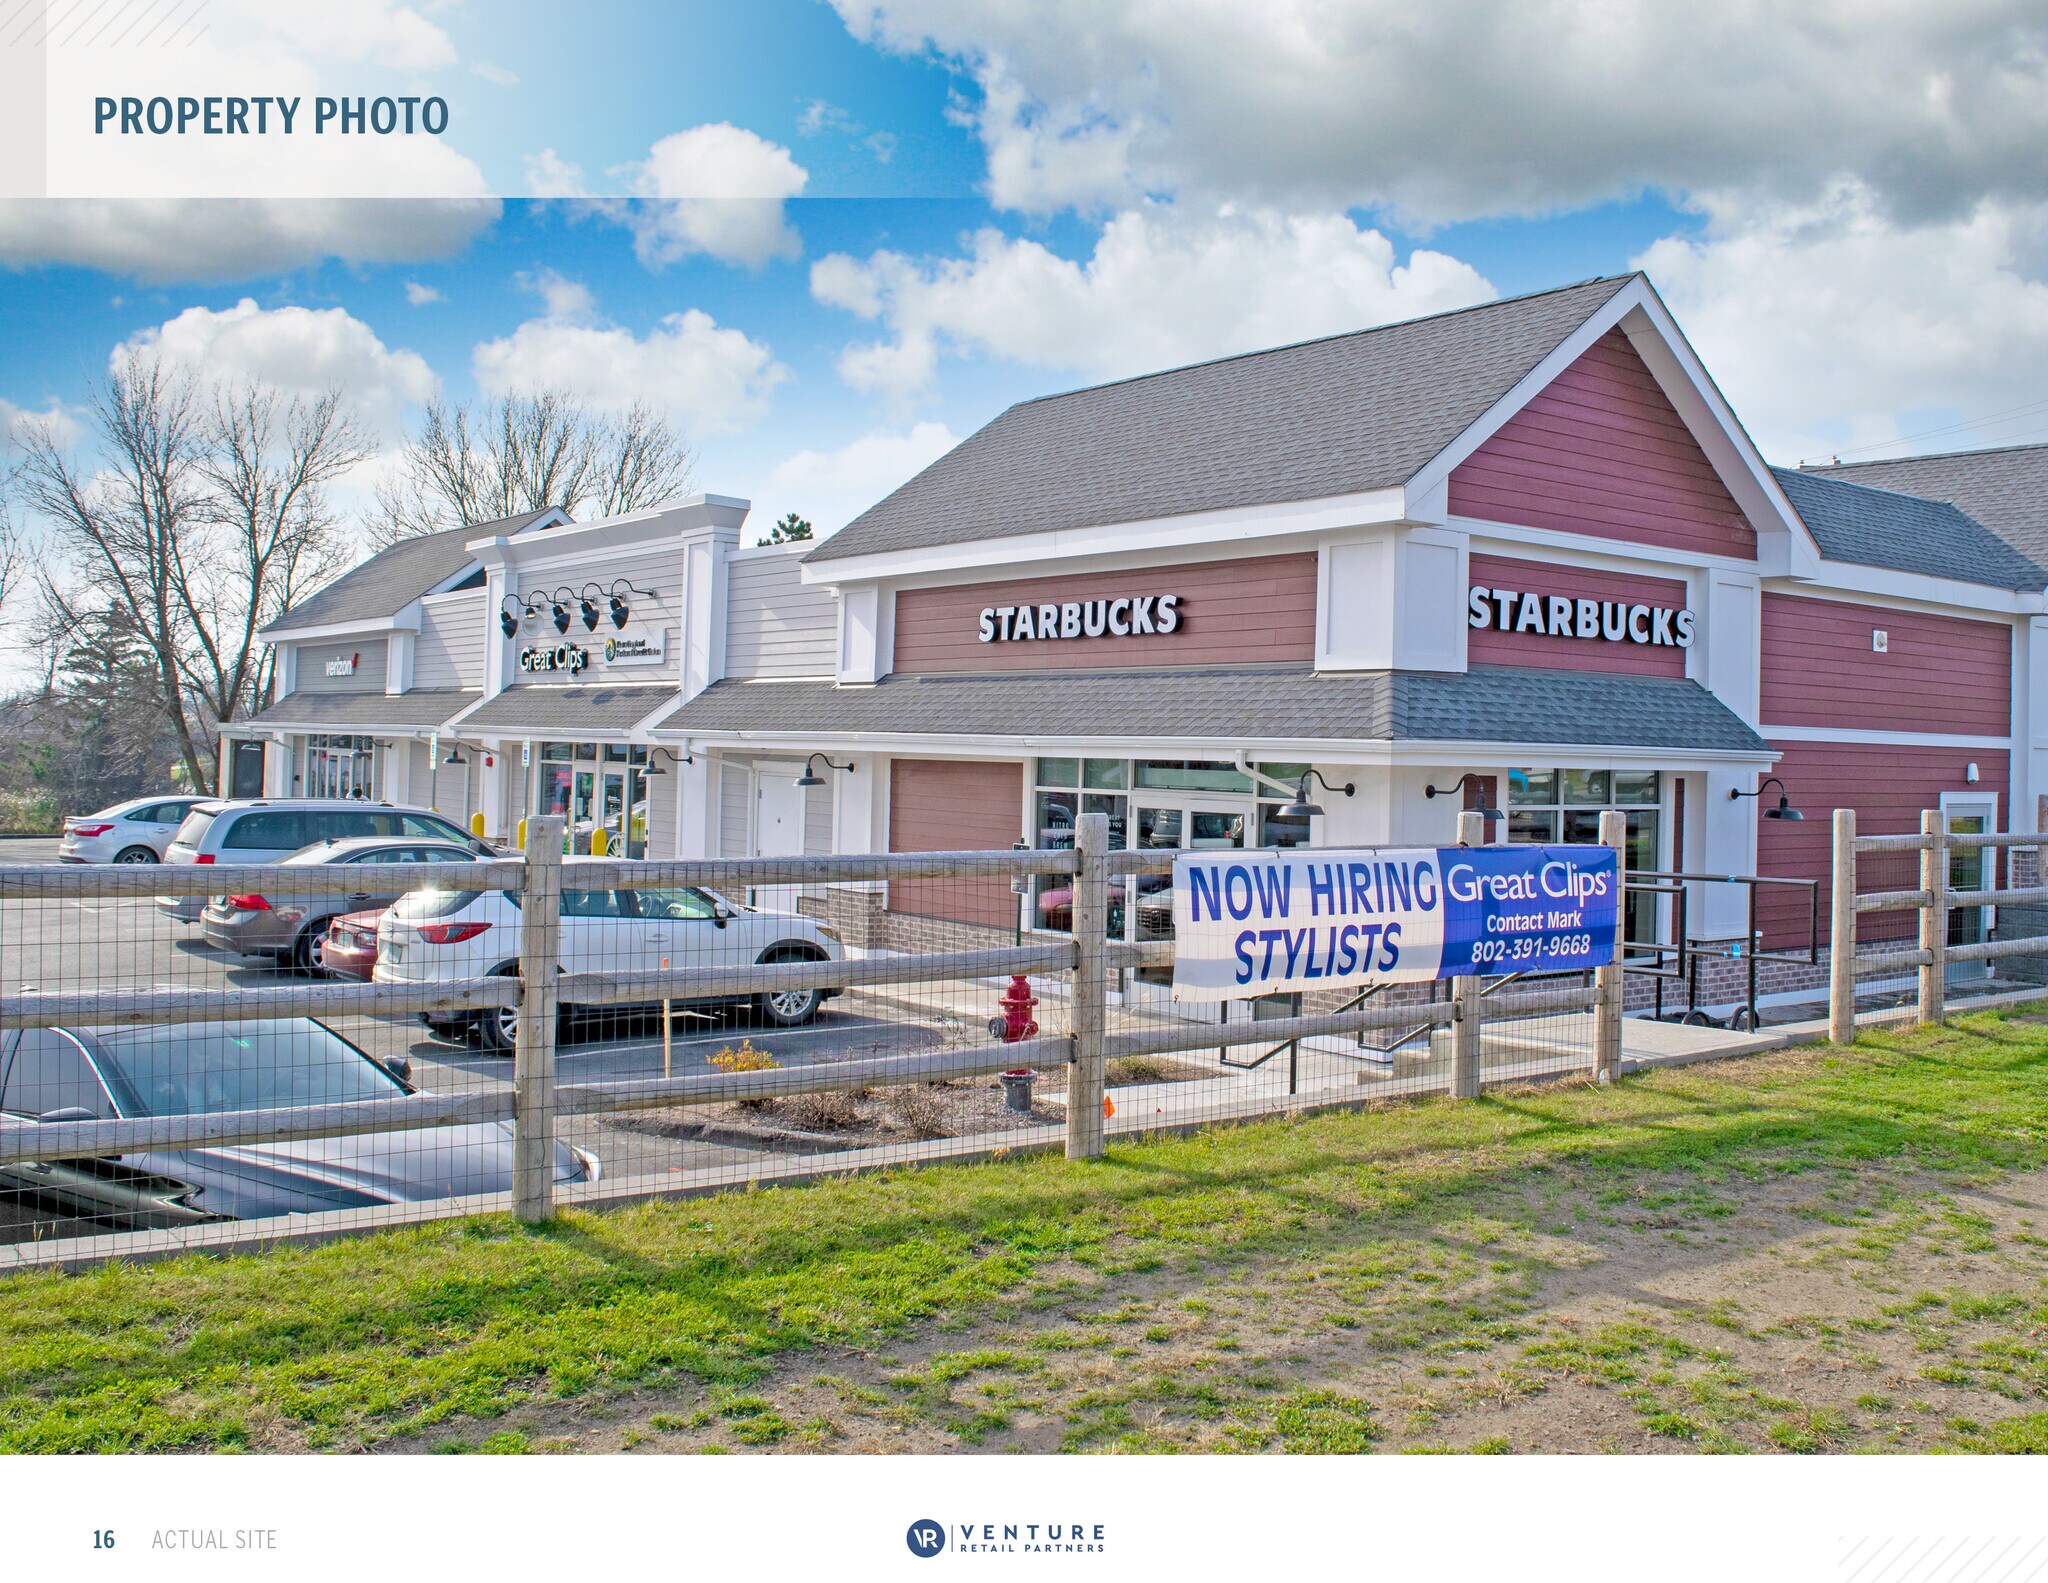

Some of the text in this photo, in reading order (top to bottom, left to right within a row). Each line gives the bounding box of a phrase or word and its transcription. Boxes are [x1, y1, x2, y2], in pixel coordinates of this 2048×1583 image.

[978, 594, 1181, 643] STARBUCKS
[1468, 586, 1695, 648] STARBUCKS
[325, 655, 352, 677] verizon
[519, 642, 586, 677] Great Clips
[1189, 861, 1437, 922] NOW HIRING
[1447, 863, 1538, 902] Great
[1486, 909, 1582, 933] Contact Mark
[1234, 922, 1402, 985] STYLISTS
[1471, 933, 1591, 964] 802-391-9668
